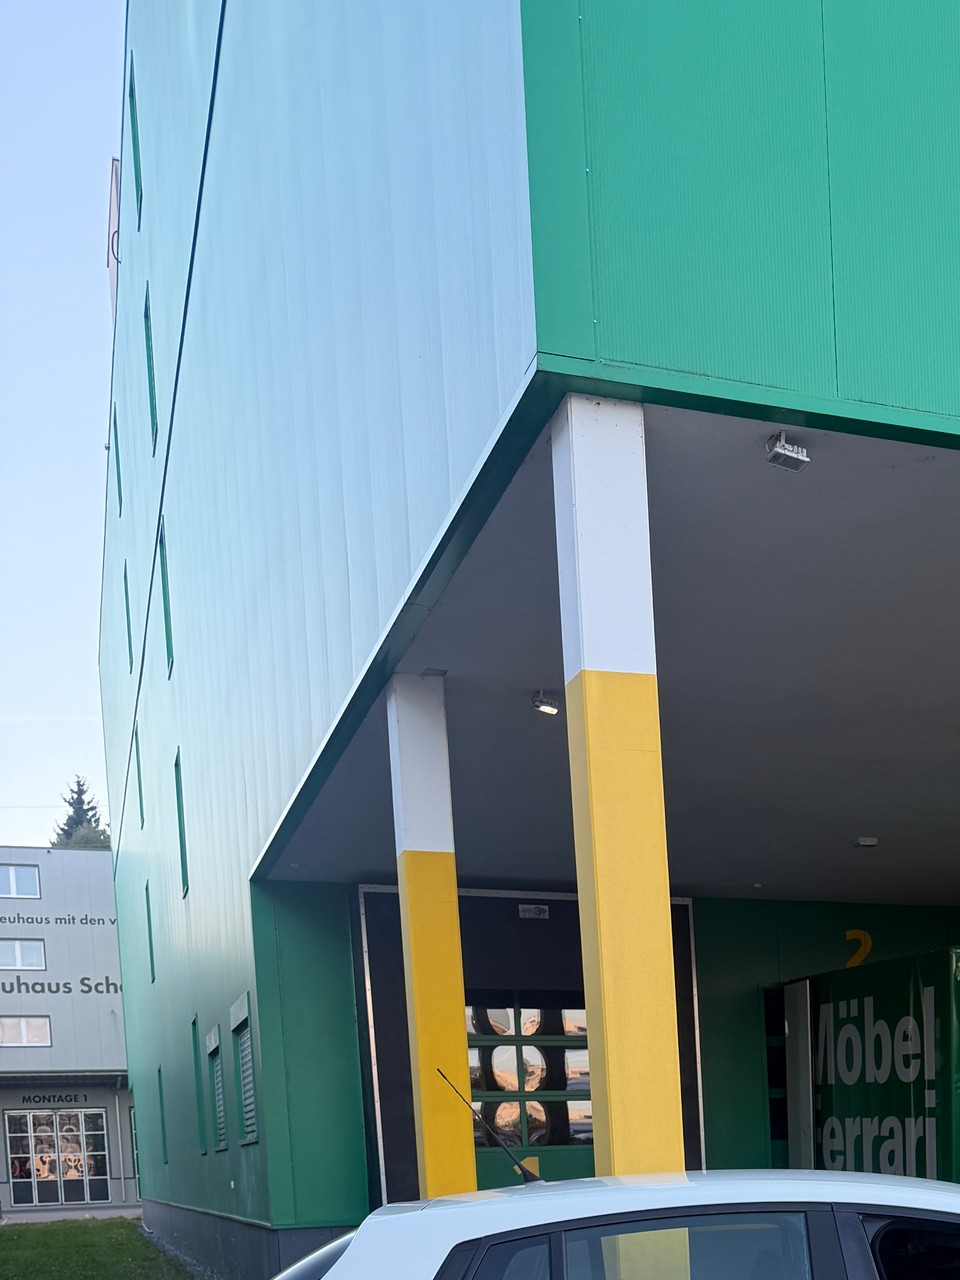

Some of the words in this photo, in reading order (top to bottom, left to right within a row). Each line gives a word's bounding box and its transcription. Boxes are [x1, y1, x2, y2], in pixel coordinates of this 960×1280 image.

[54, 913, 77, 925] mit
[79, 914, 105, 925] den
[79, 975, 124, 995] Sch
[22, 1094, 79, 1104] MONTAGE
[83, 1094, 88, 1103] 1
